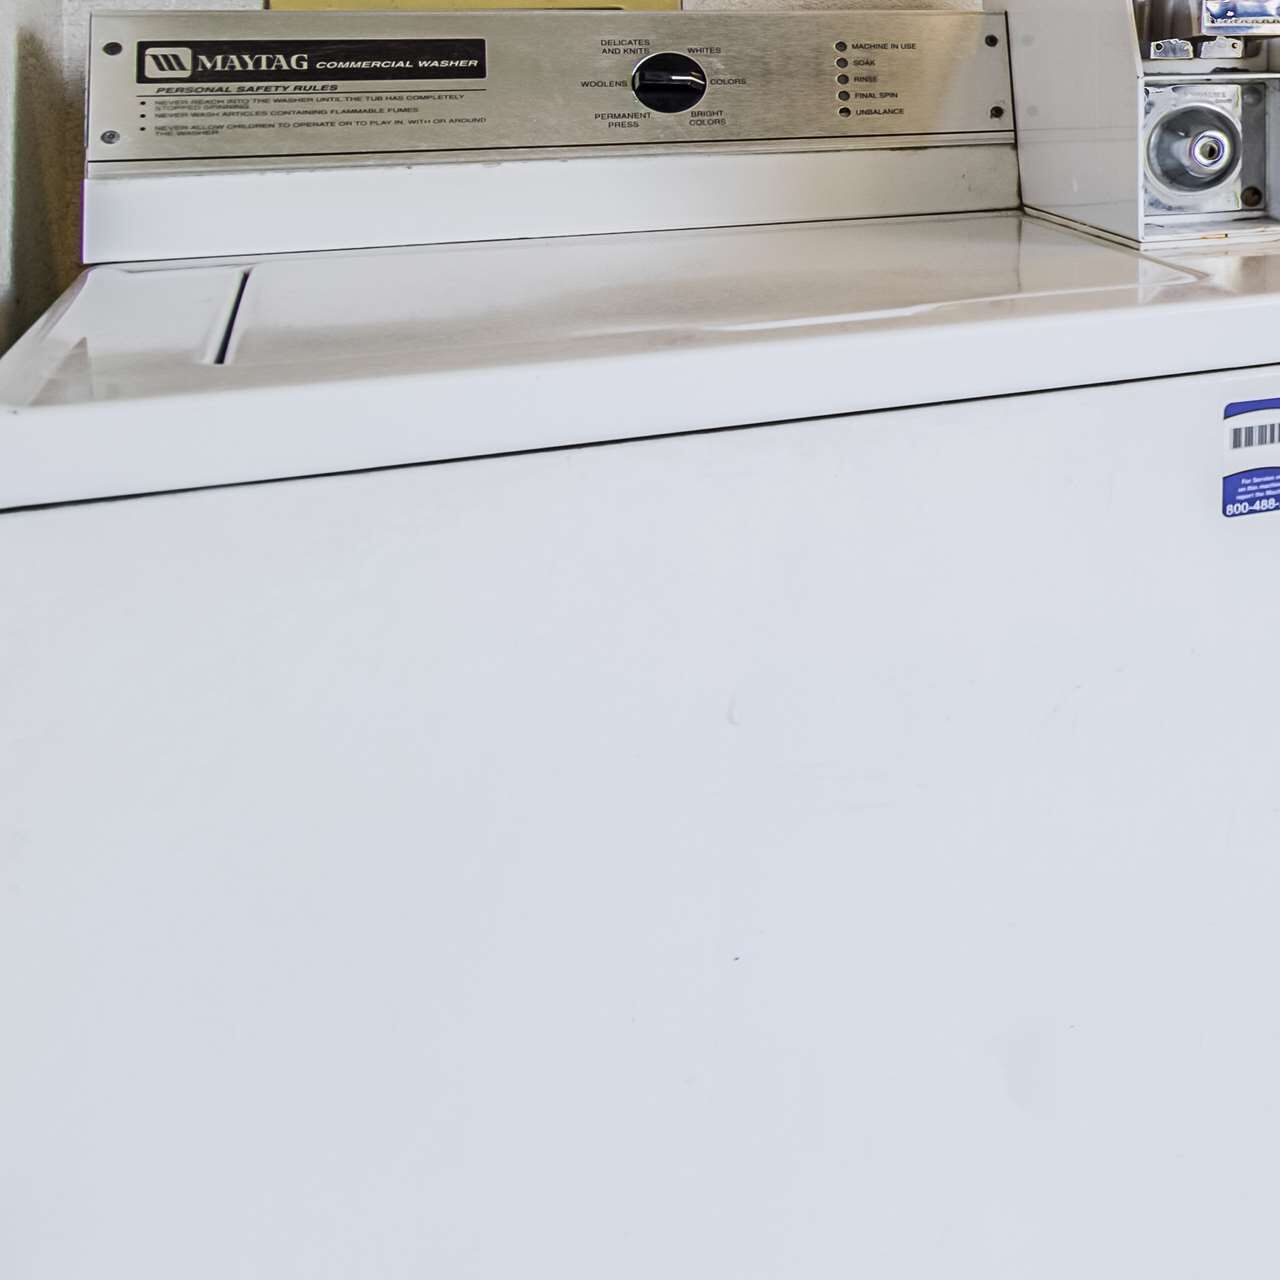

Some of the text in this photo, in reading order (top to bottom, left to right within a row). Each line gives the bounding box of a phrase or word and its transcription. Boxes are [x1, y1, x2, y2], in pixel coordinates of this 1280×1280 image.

[600, 39, 651, 47] DELICATES
[601, 46, 651, 55] AND KNITS
[687, 46, 722, 54] WHITES
[197, 53, 479, 72] MAYTAG COMMERCIAL WASHER
[580, 80, 628, 88] WOOLENS
[709, 78, 747, 86] COLORS
[155, 84, 339, 94] PERSONAL SAFETY RULES
[594, 111, 651, 120] PERMANENT
[690, 110, 724, 118] BRIGHT
[607, 120, 640, 128] PRESS
